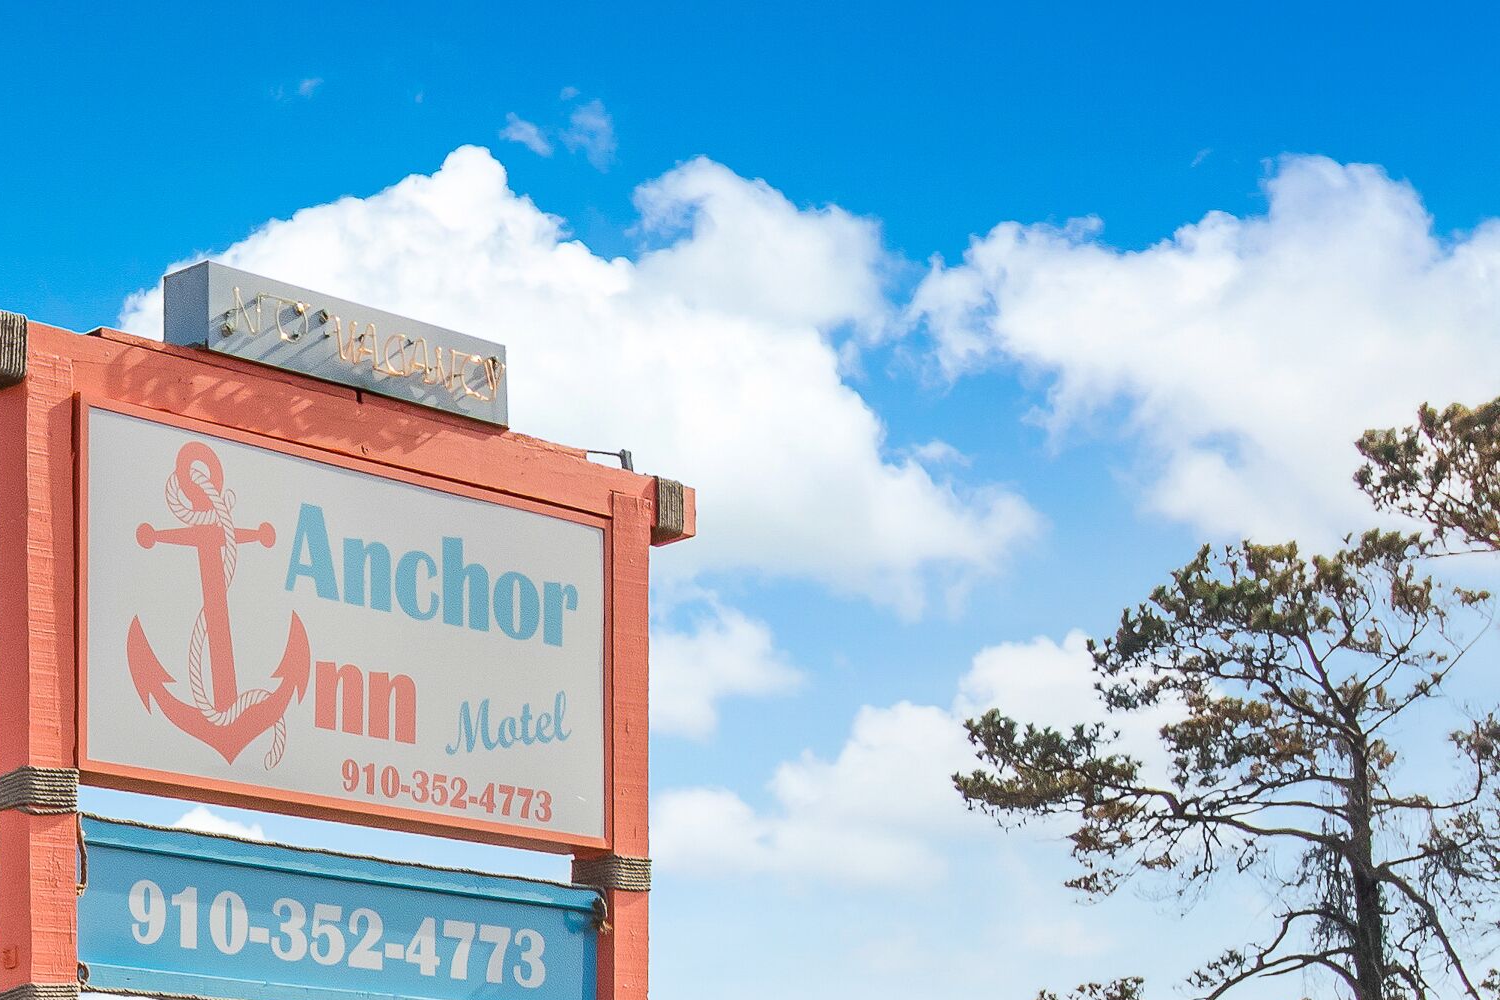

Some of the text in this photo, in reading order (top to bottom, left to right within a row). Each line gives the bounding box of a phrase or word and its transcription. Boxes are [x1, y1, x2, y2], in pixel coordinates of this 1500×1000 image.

[233, 286, 505, 401] NO VACANCY
[285, 502, 579, 647] Anchor
[445, 690, 572, 755] Motel
[341, 758, 553, 823] 910-352-4773
[128, 879, 546, 988] 910-352-4773
